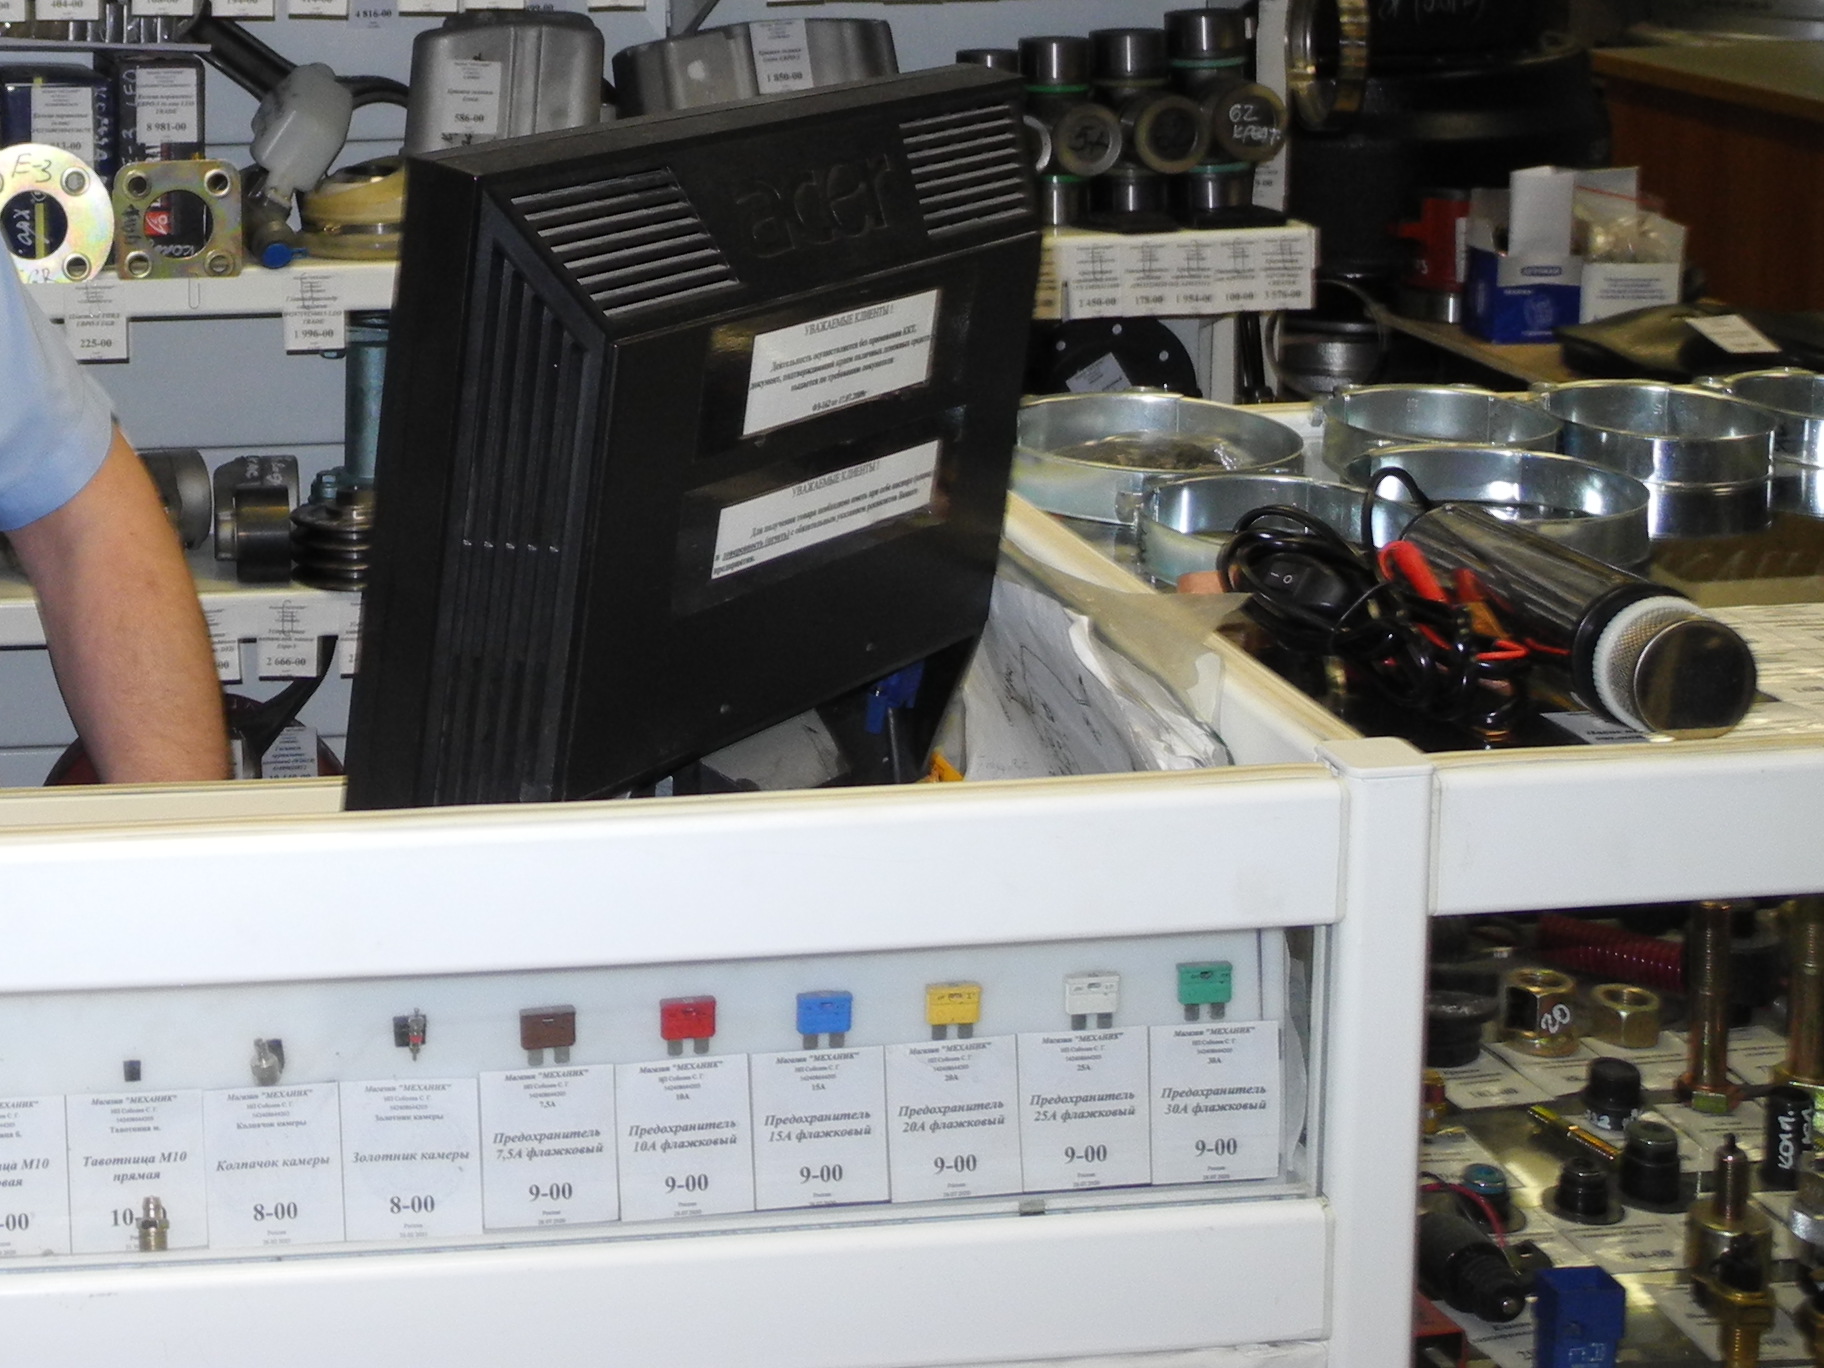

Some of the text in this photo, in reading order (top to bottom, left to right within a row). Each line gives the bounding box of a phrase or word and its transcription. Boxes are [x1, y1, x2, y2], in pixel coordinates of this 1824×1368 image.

[804, 316, 853, 336] УВАЖАЕМЫЕ
[855, 305, 890, 324] КЛИЕНТЫ
[1030, 1090, 1135, 1107] Предохранитель
[1160, 1084, 1267, 1102] Предохранитель
[898, 1099, 1004, 1118] Предохранитель
[1060, 1106, 1135, 1123] флажковый
[1191, 1099, 1267, 1116] флажковый
[628, 1118, 737, 1138] Предохранитель
[764, 1109, 871, 1129] Предохранитель
[929, 1114, 1005, 1134] флажковый
[493, 1128, 601, 1146] Предохранитель
[659, 1135, 737, 1153] флажковый
[795, 1126, 872, 1144] флажковый
[351, 1148, 470, 1165] Золотник камеры
[525, 1142, 604, 1160] флажковый
[1064, 1145, 1108, 1164] 9-00
[1195, 1138, 1238, 1157] 9-00
[20, 1156, 51, 1171] М10
[83, 1150, 187, 1168] Тавотница М10
[215, 1155, 331, 1173] Колпачок камеры
[934, 1154, 977, 1175] 9-00
[113, 1170, 161, 1183] прямая
[664, 1173, 709, 1193] 9-00
[799, 1164, 843, 1184] 9-00
[528, 1183, 573, 1202] 9-00
[253, 1201, 298, 1222] 8-00
[389, 1195, 436, 1215] 8-00
